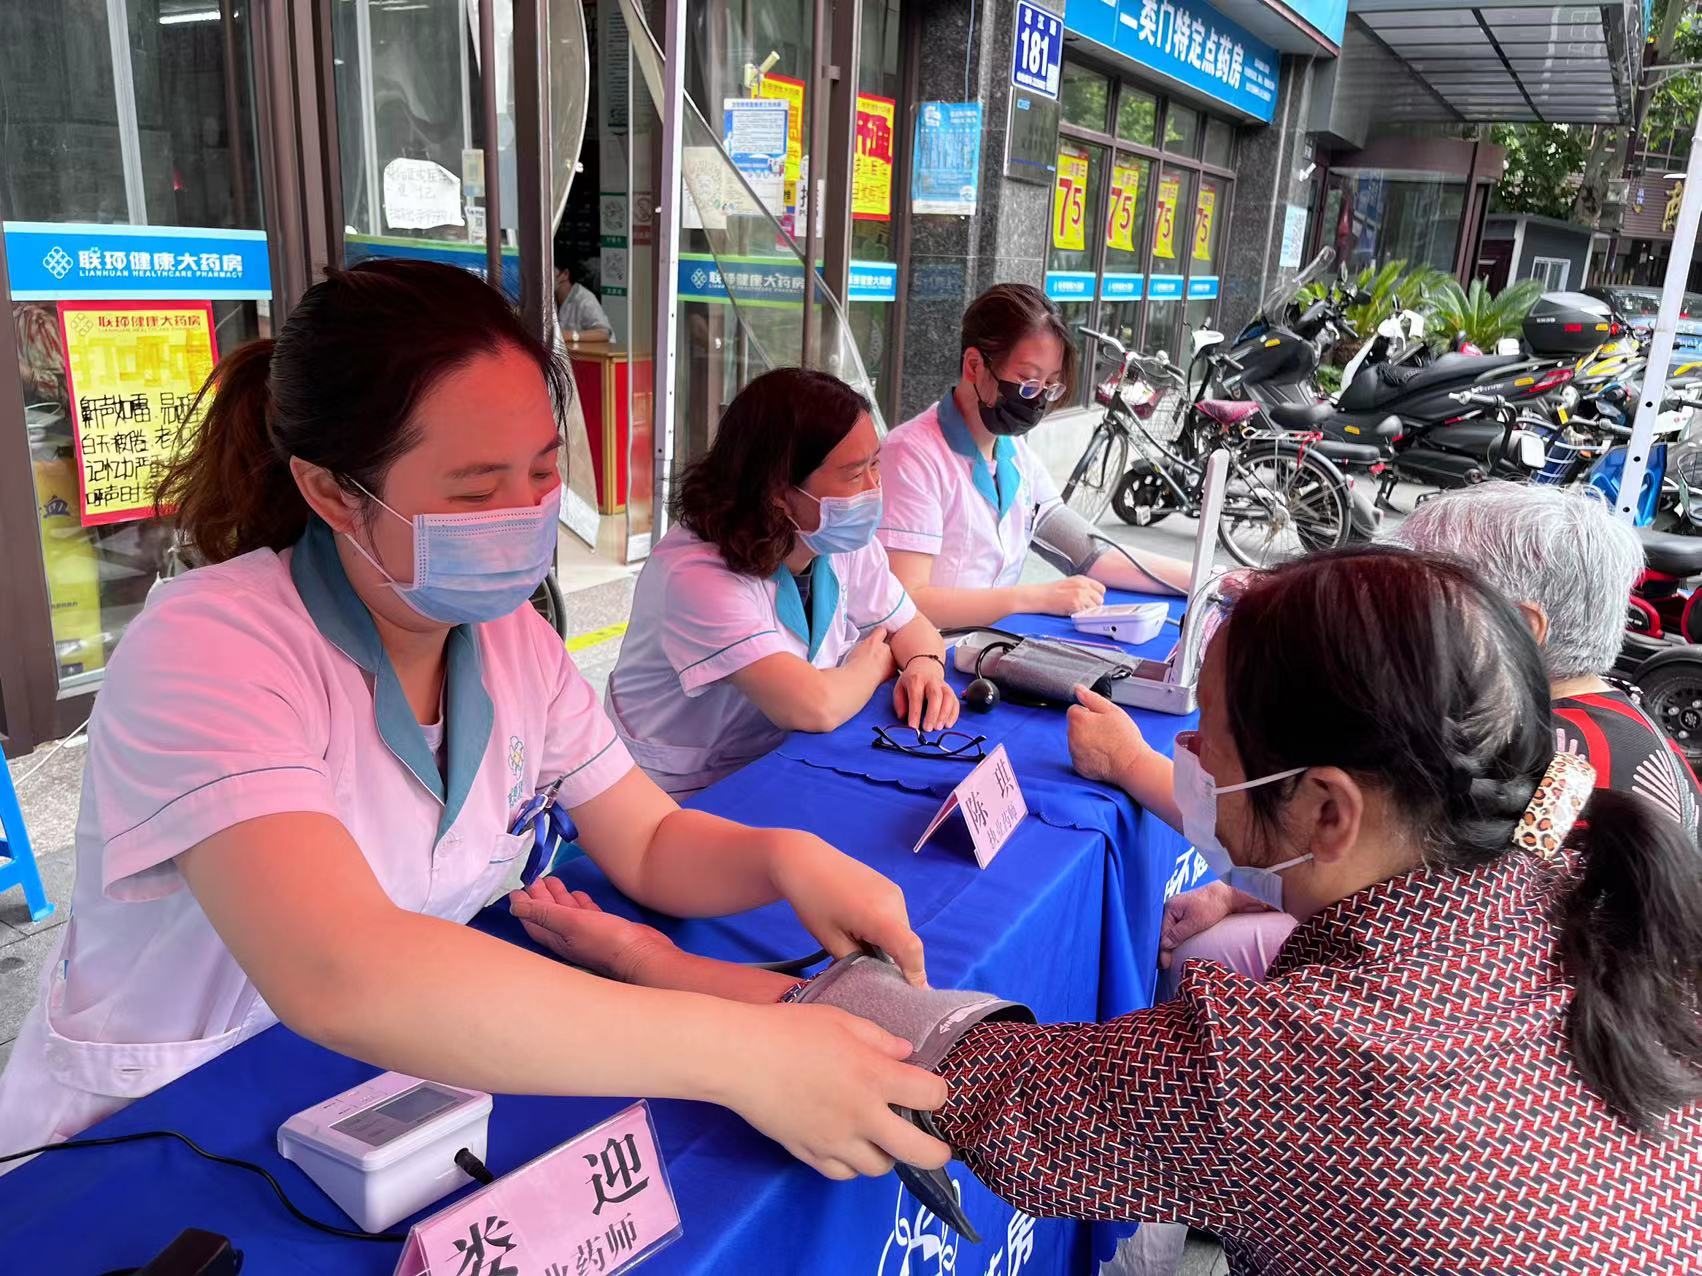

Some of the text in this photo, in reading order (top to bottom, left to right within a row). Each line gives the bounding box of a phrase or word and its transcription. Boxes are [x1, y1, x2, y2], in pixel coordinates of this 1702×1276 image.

[1021, 27, 1049, 77] 181
[79, 249, 243, 272] 联环健康大药房
[132, 270, 193, 278] HEALTHCARE
[195, 271, 243, 279] PHARMACY
[98, 314, 201, 328] 联环健康大药房
[964, 758, 1015, 835] 陈 琪
[585, 1133, 649, 1216] 迎
